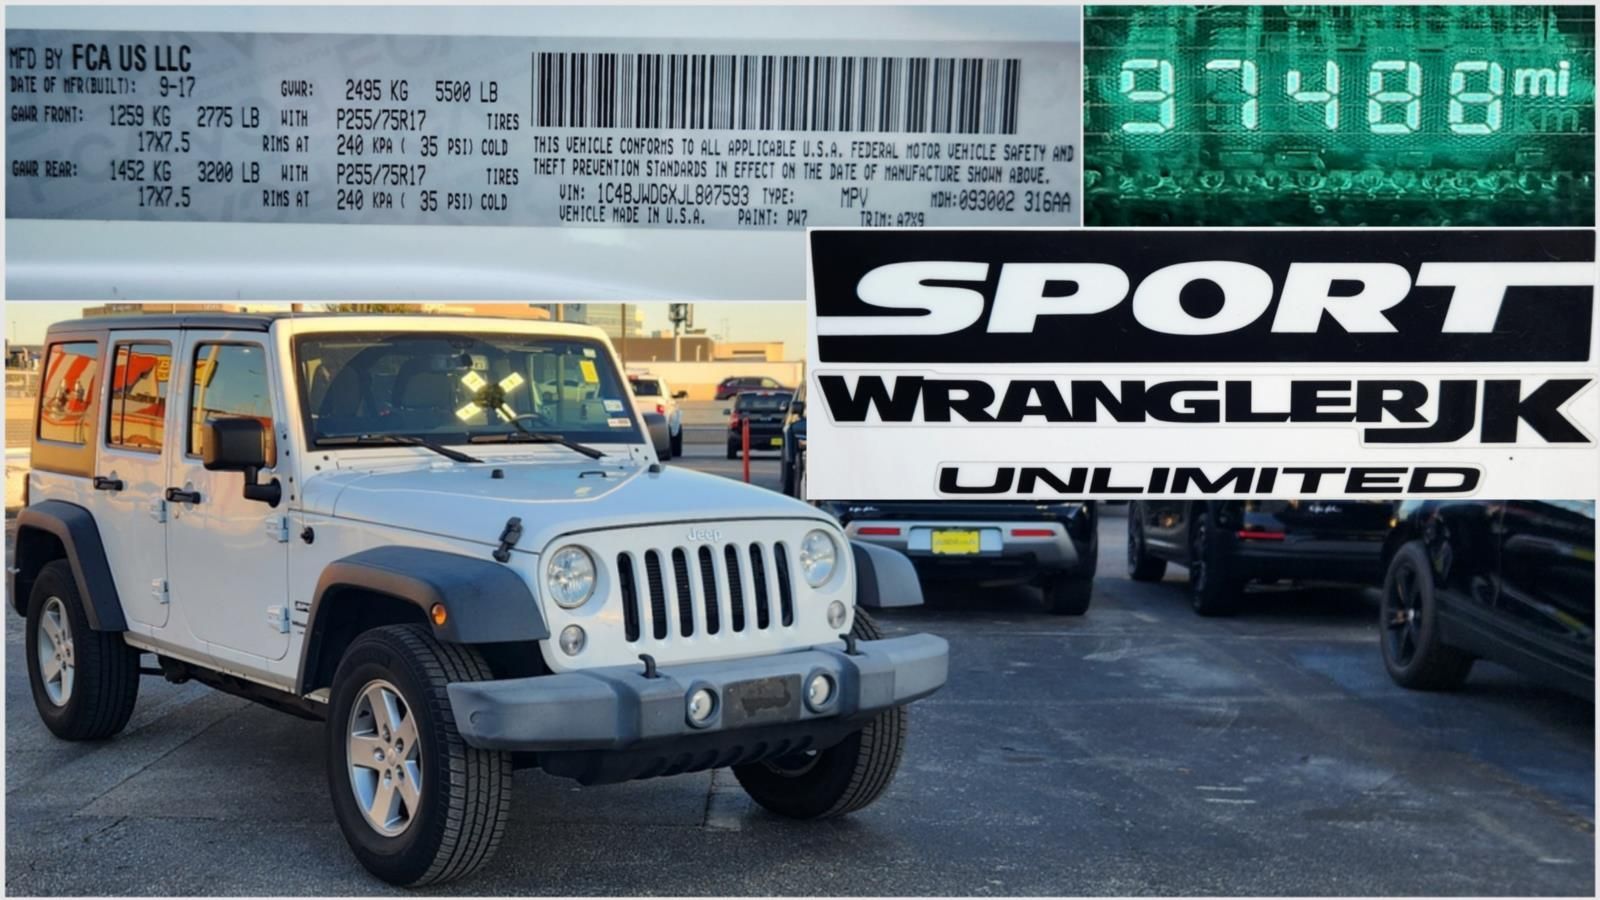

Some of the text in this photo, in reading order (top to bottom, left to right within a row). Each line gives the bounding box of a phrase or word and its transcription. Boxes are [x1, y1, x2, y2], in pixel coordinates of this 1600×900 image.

[9, 44, 191, 72] MFD BY FCA US LLC
[10, 76, 497, 102] DATE OF MFR(BUILT): 9-17 GVWR: 2495 KG 5500 LB
[1119, 59, 1569, 134] 97488 mi
[11, 105, 519, 130] GAWR FRONT: 1259 KG 2775 LB WITH P255/75R17 TIRES
[139, 131, 190, 152] 17X7.5
[263, 135, 289, 152] RIMS
[296, 136, 309, 152] AT
[337, 134, 363, 155] 240
[373, 137, 392, 153] KPA
[421, 136, 437, 157] 35
[448, 138, 472, 155] PSI)
[482, 139, 507, 156] COLD
[534, 136, 1073, 162] THIS VEHICLE CONFORMS TO ALL APPLICABLE U.S.A. FEDERAL MOTOR VEHICLE SAFETY AND
[12, 160, 518, 186] GAWR REAR: 1452 KG 3200 LB WITH P255/75R17 TIRES
[534, 158, 1049, 184] THEFT PREVENTION STANDARDS IN EFFECT ON THE DATE OF MANUFACTURE SHOWN ABOVE.
[139, 186, 190, 207] 17X7.5
[263, 190, 289, 207] RIMS
[297, 190, 309, 207] AT
[338, 189, 363, 210] 240
[373, 192, 392, 208] KPA
[421, 190, 437, 211] 35
[448, 193, 472, 210] PSI)
[481, 194, 507, 210] COLD
[560, 184, 584, 200] VIN:
[598, 183, 749, 205] 1C4BJWDGXJL807593
[763, 188, 793, 205] TYPE:
[841, 187, 867, 208] MPV
[1025, 191, 1071, 212] 316AA
[559, 204, 924, 227] VEHICLE MADE IN U.S.A. PAINT: PW7 TRIM: A7X9
[816, 261, 1595, 336] SPORT
[938, 467, 1481, 494] UNLIMITED
[687, 527, 721, 542] Jeep
